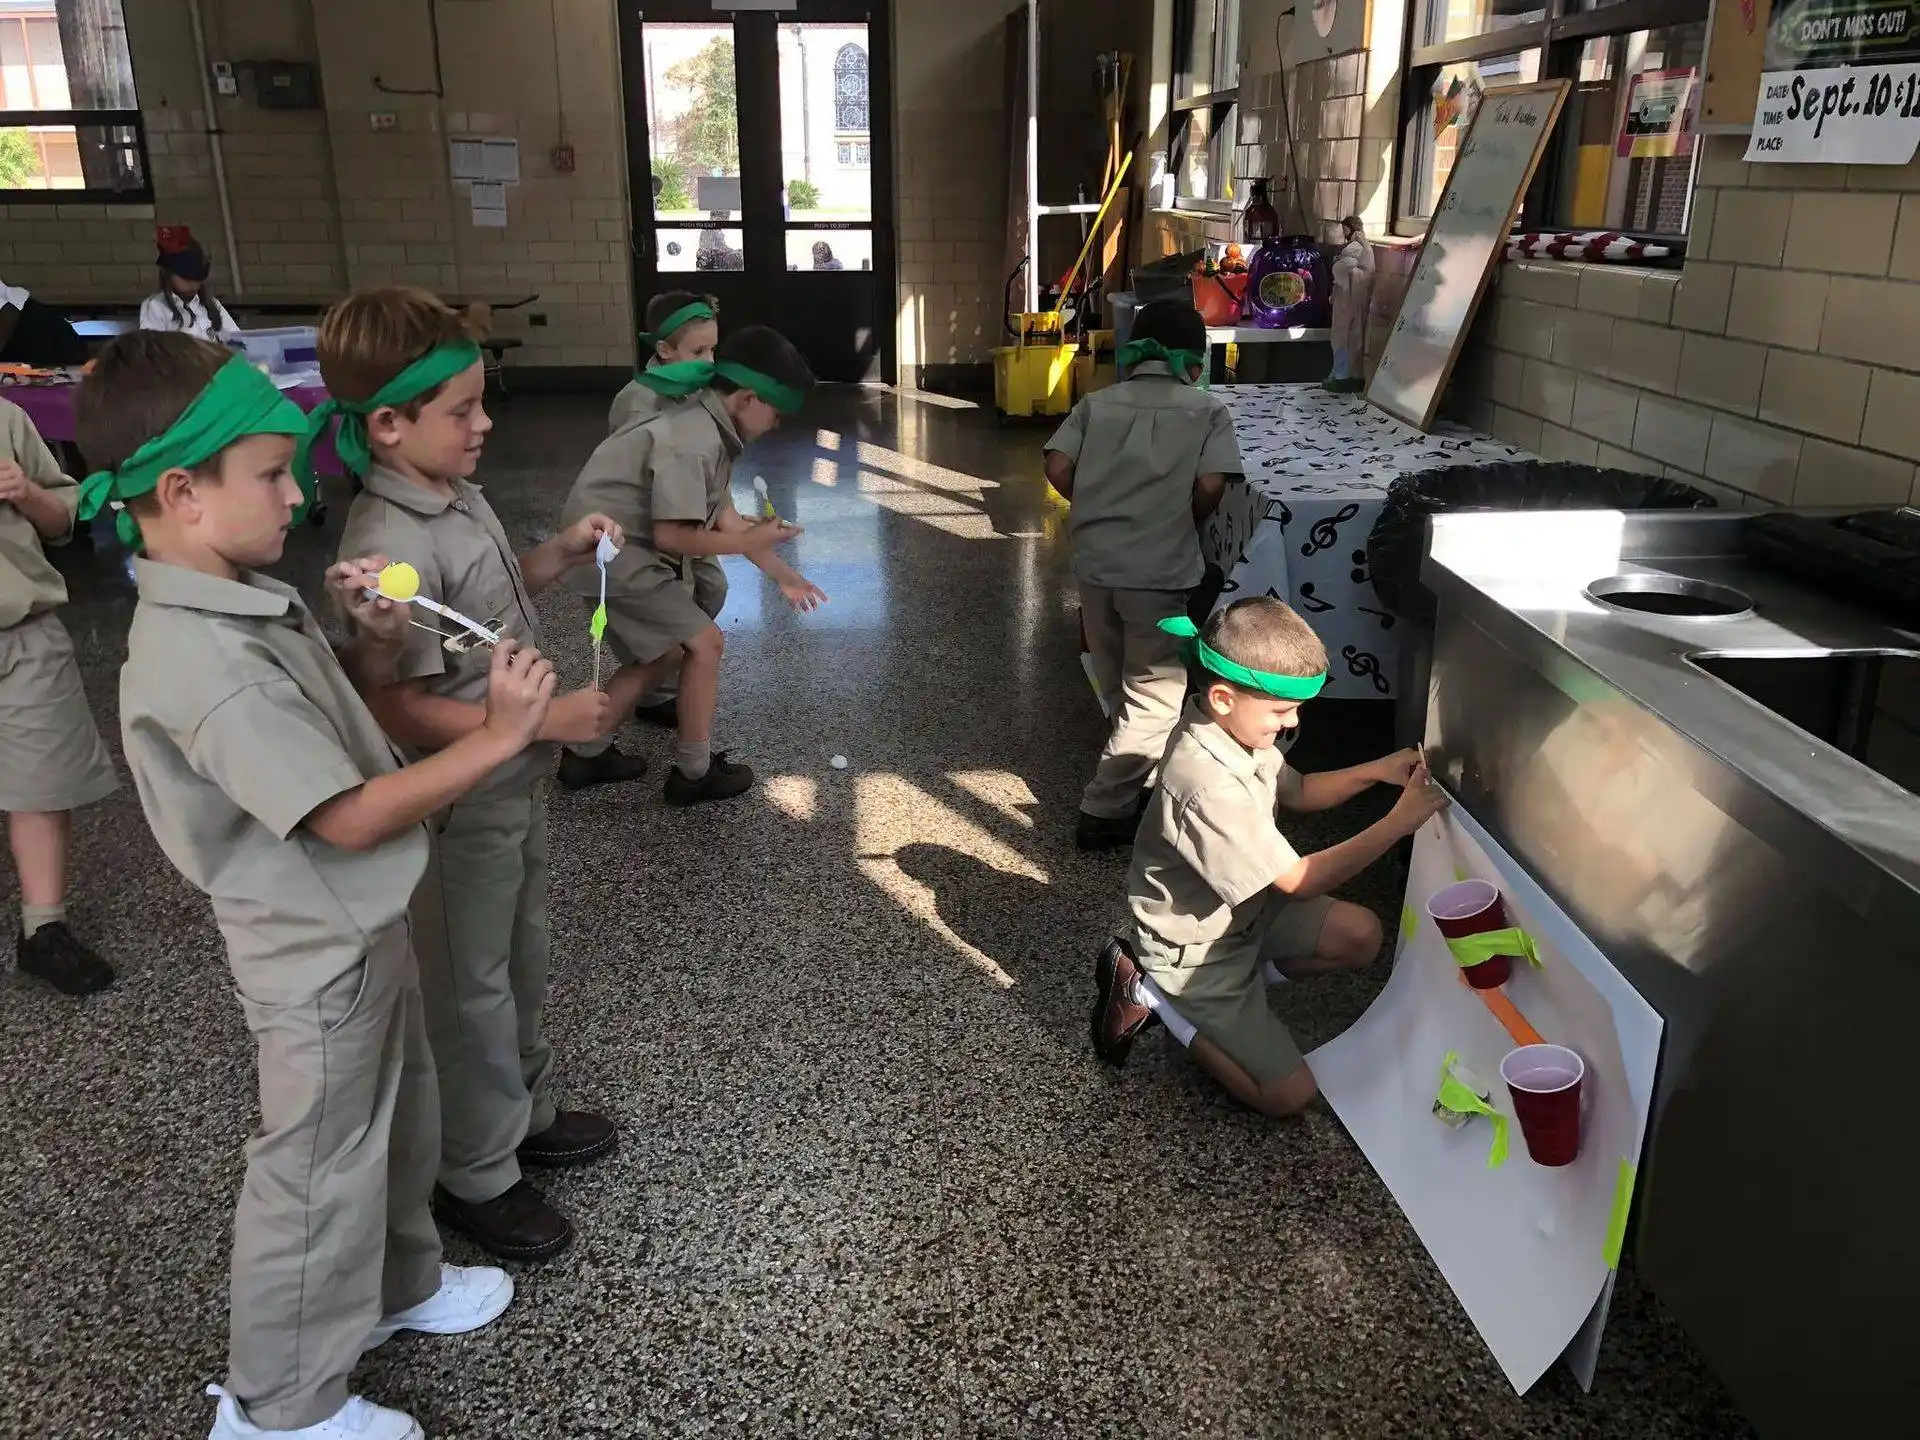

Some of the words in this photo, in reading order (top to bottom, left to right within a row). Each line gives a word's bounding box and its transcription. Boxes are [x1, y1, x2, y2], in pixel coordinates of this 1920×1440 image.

[1801, 17, 1841, 41] DON'T
[1843, 14, 1875, 38] MISS
[1877, 9, 1907, 34] OUT!
[1766, 84, 1790, 99] DATE:
[1787, 75, 1860, 139] Sept.
[1762, 111, 1784, 125] TIME:
[1756, 136, 1784, 151] PLACE:
